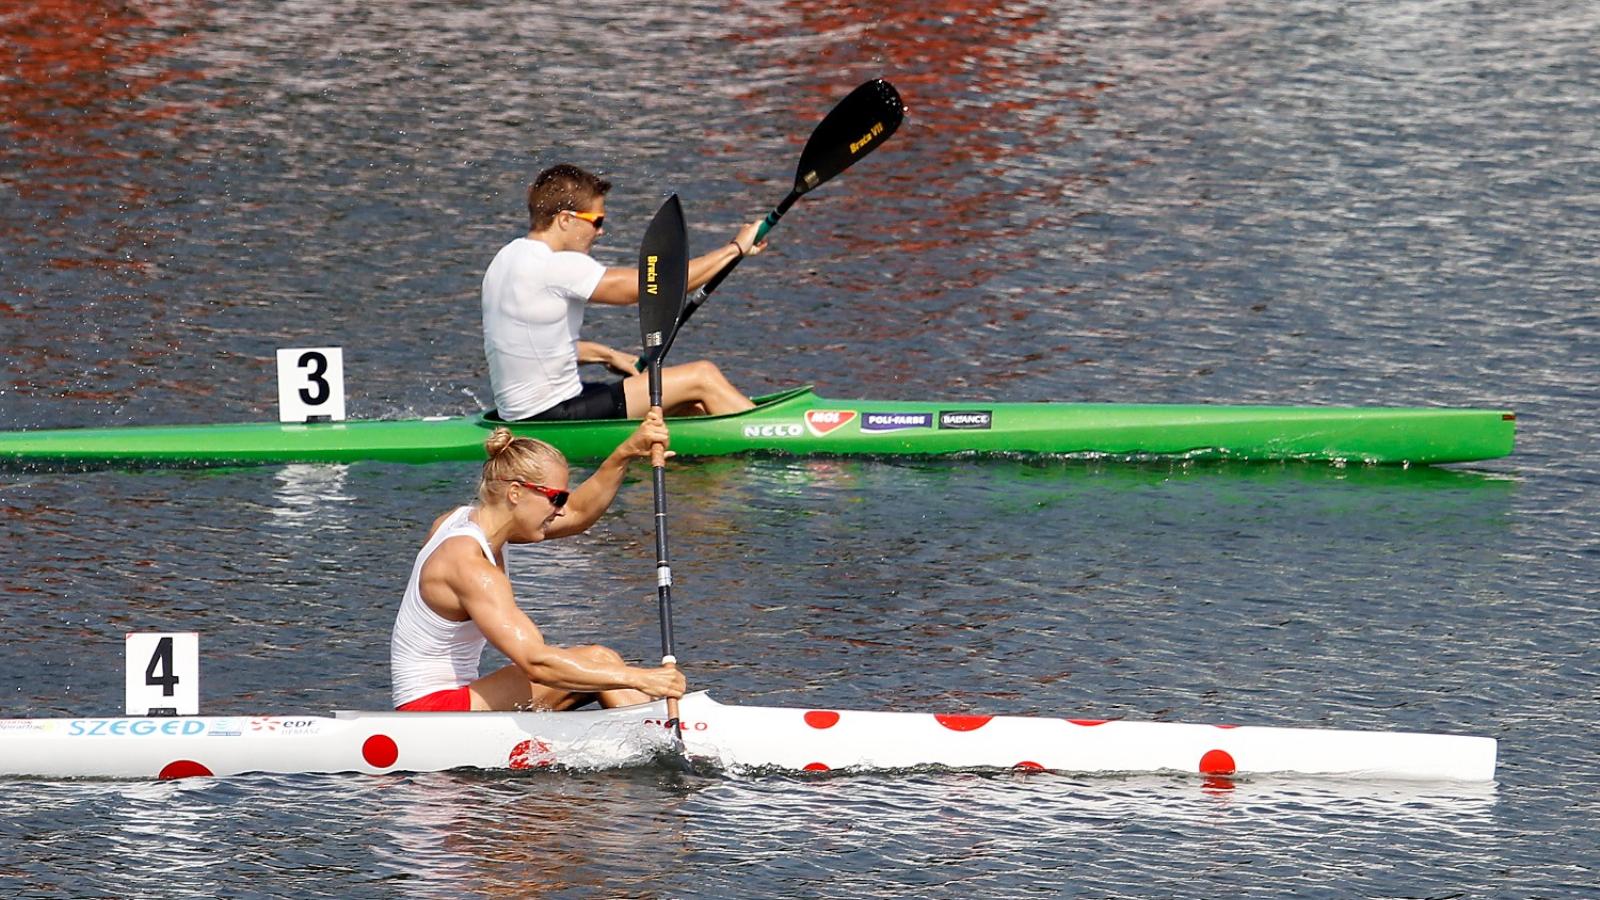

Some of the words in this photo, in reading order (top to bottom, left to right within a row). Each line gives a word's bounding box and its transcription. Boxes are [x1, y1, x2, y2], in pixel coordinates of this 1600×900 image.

[647, 284, 658, 295] IV
[297, 351, 330, 406] 3
[811, 412, 840, 422] MOL
[868, 415, 926, 425] POLI-FARBE
[145, 636, 179, 697] 4
[68, 719, 205, 736] SZEGED
